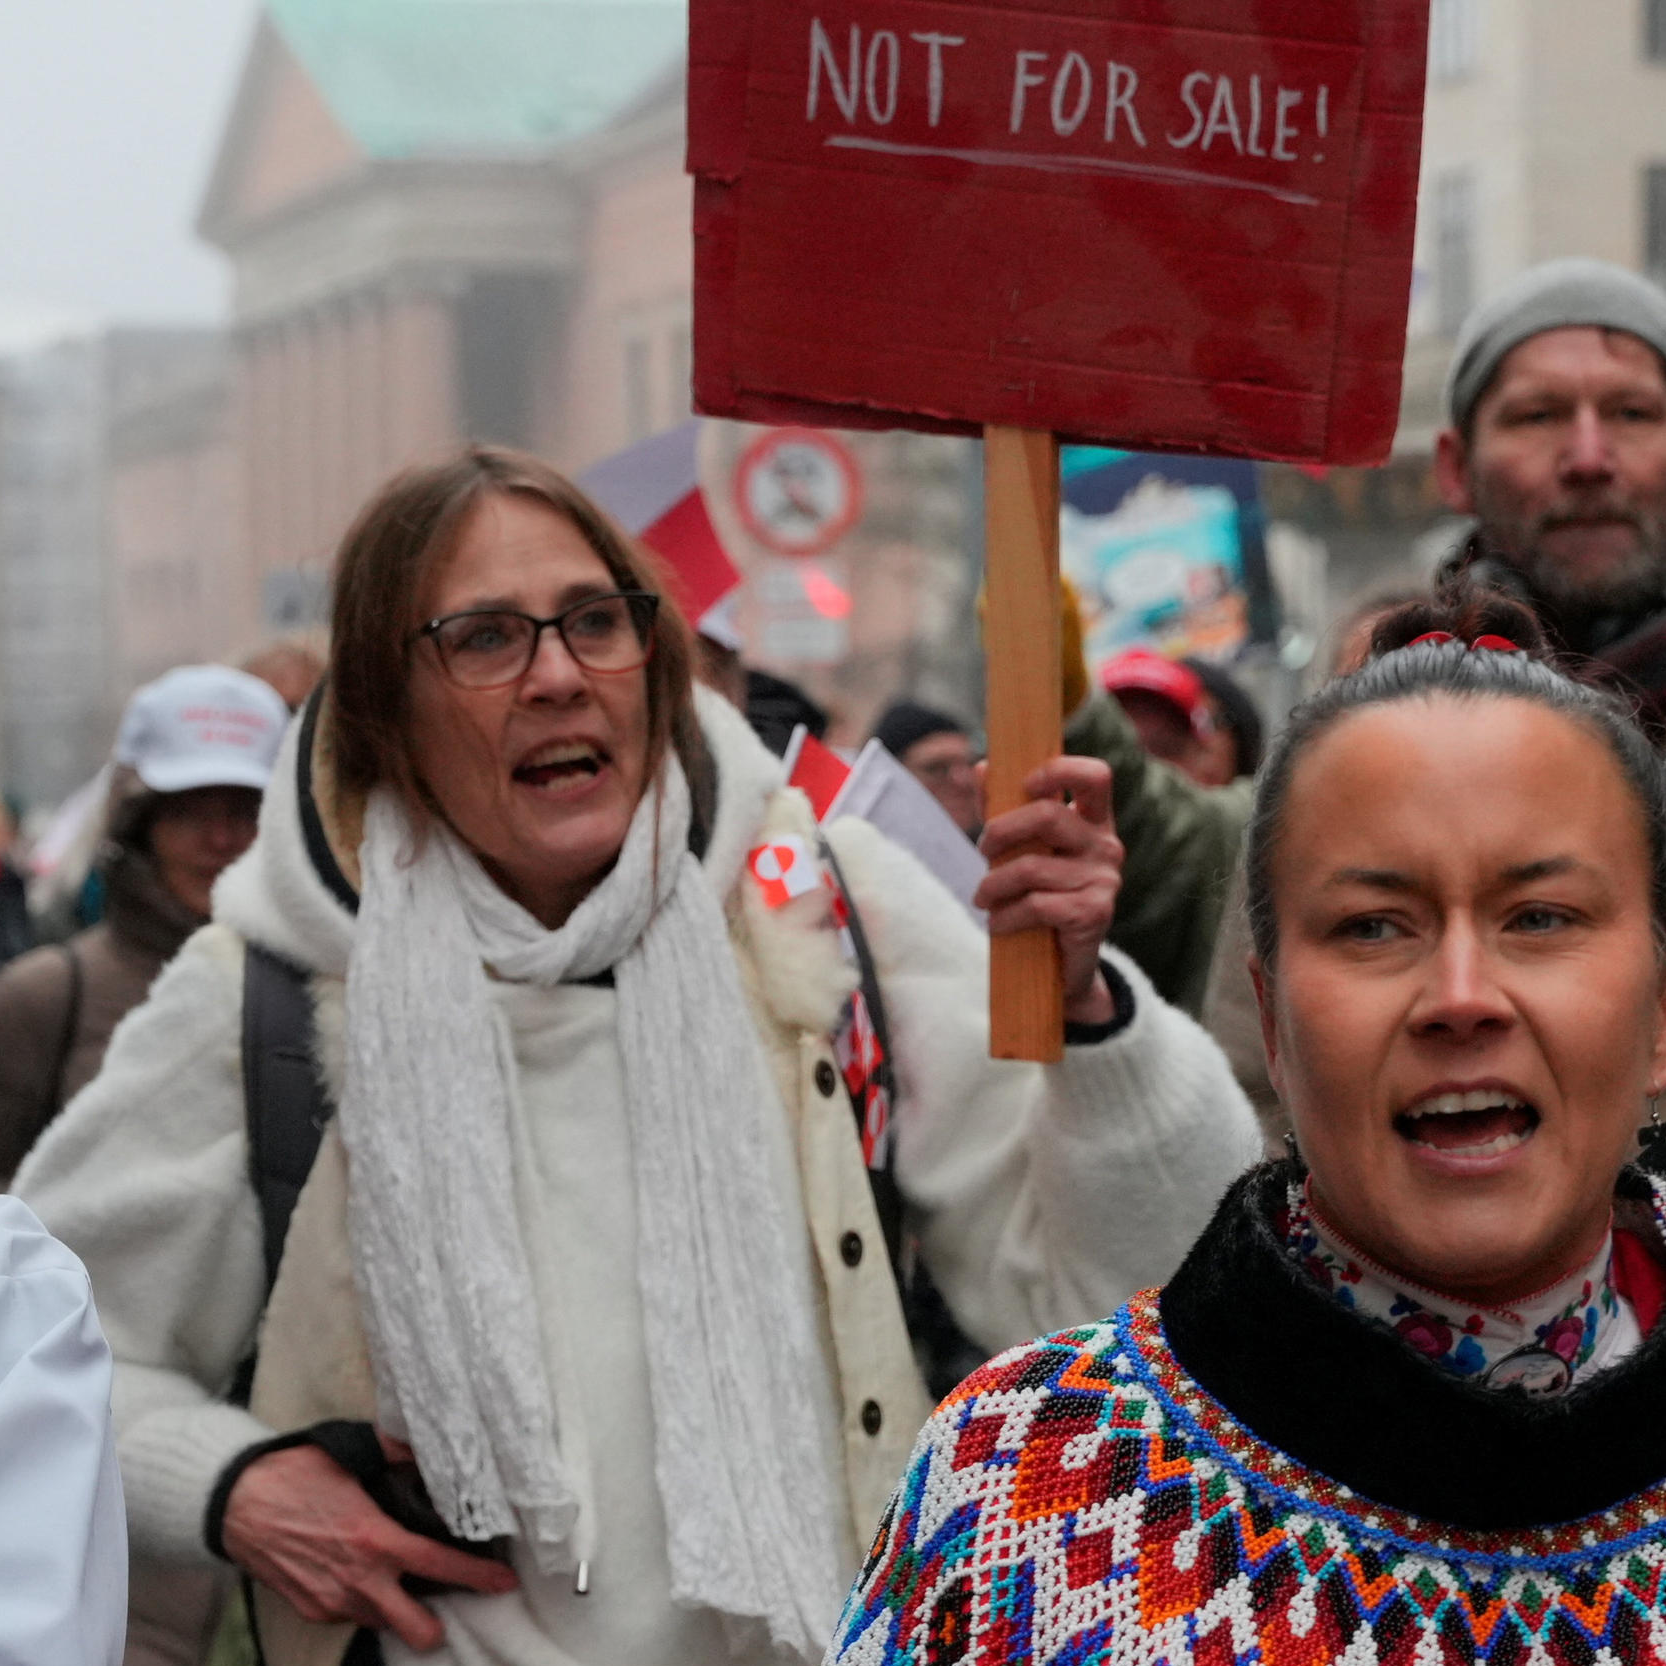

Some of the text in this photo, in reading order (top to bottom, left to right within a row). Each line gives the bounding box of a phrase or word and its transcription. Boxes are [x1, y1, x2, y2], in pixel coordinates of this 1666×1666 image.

[806, 17, 1330, 163] NOT FOR SALE!
